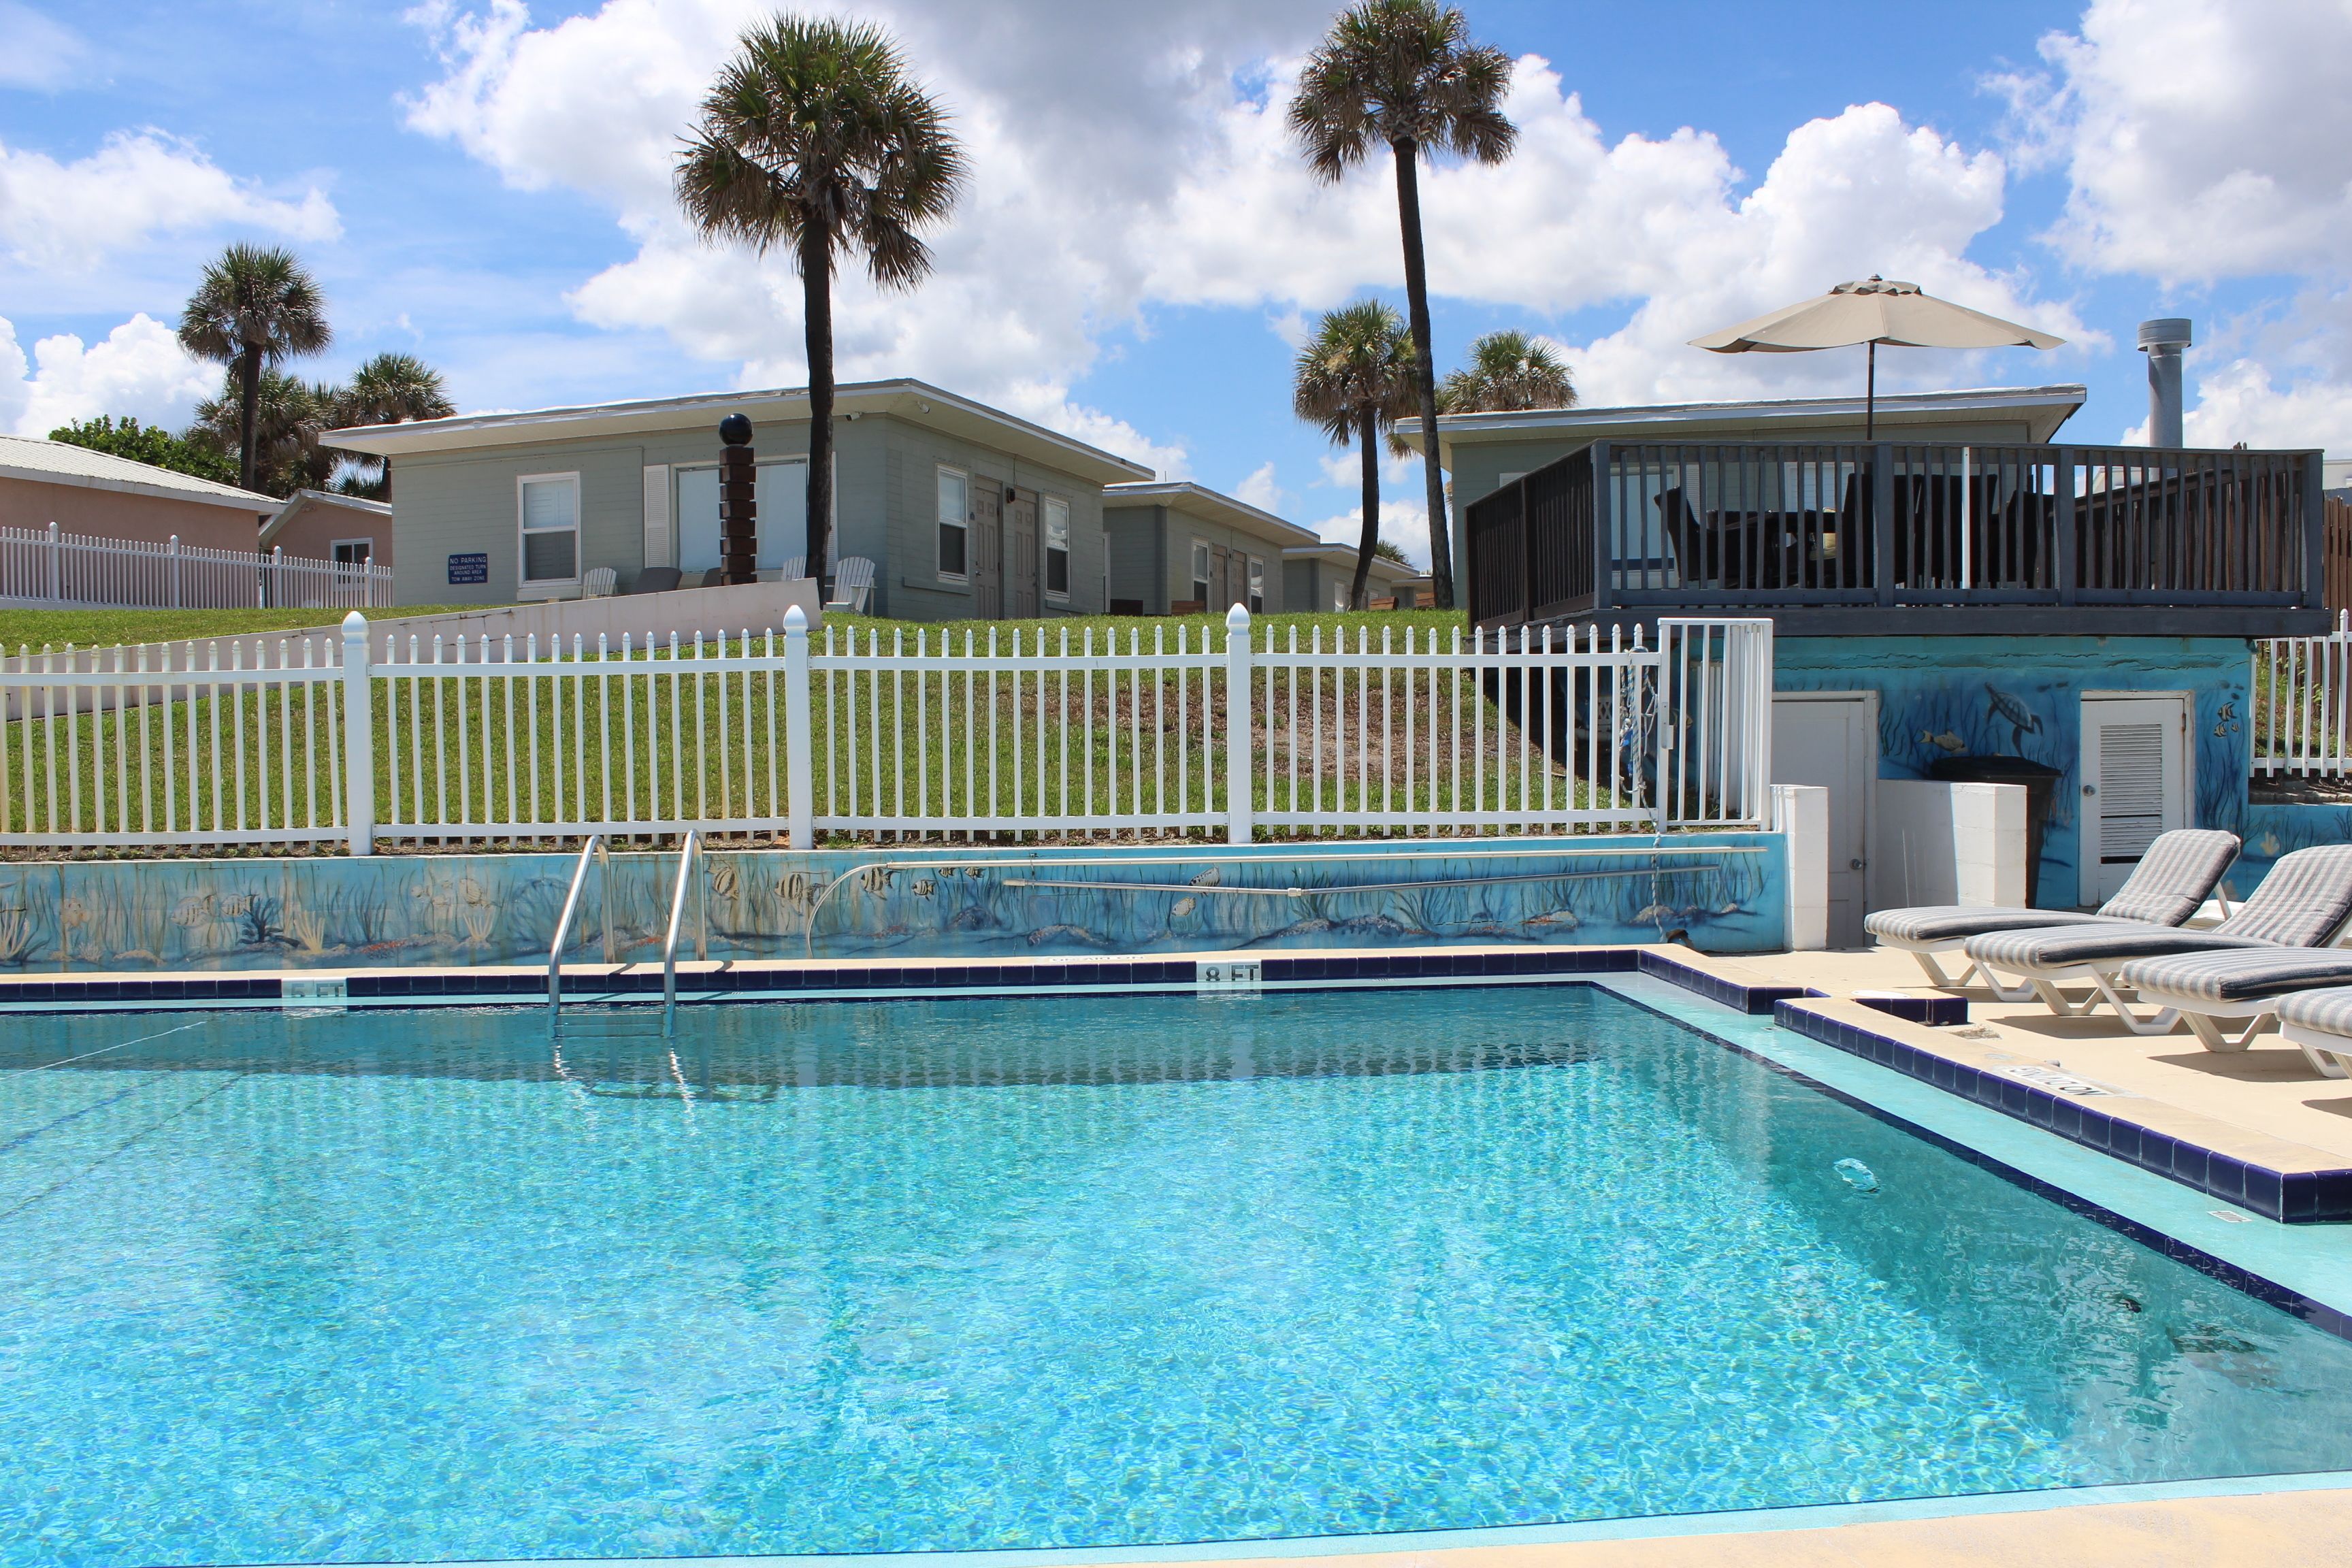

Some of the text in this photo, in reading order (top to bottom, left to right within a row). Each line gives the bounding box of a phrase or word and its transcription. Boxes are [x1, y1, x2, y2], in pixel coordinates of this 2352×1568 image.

[1205, 964, 1259, 981] 8 FT
[316, 982, 344, 997] FT
[2058, 1085, 2108, 1096] NO
